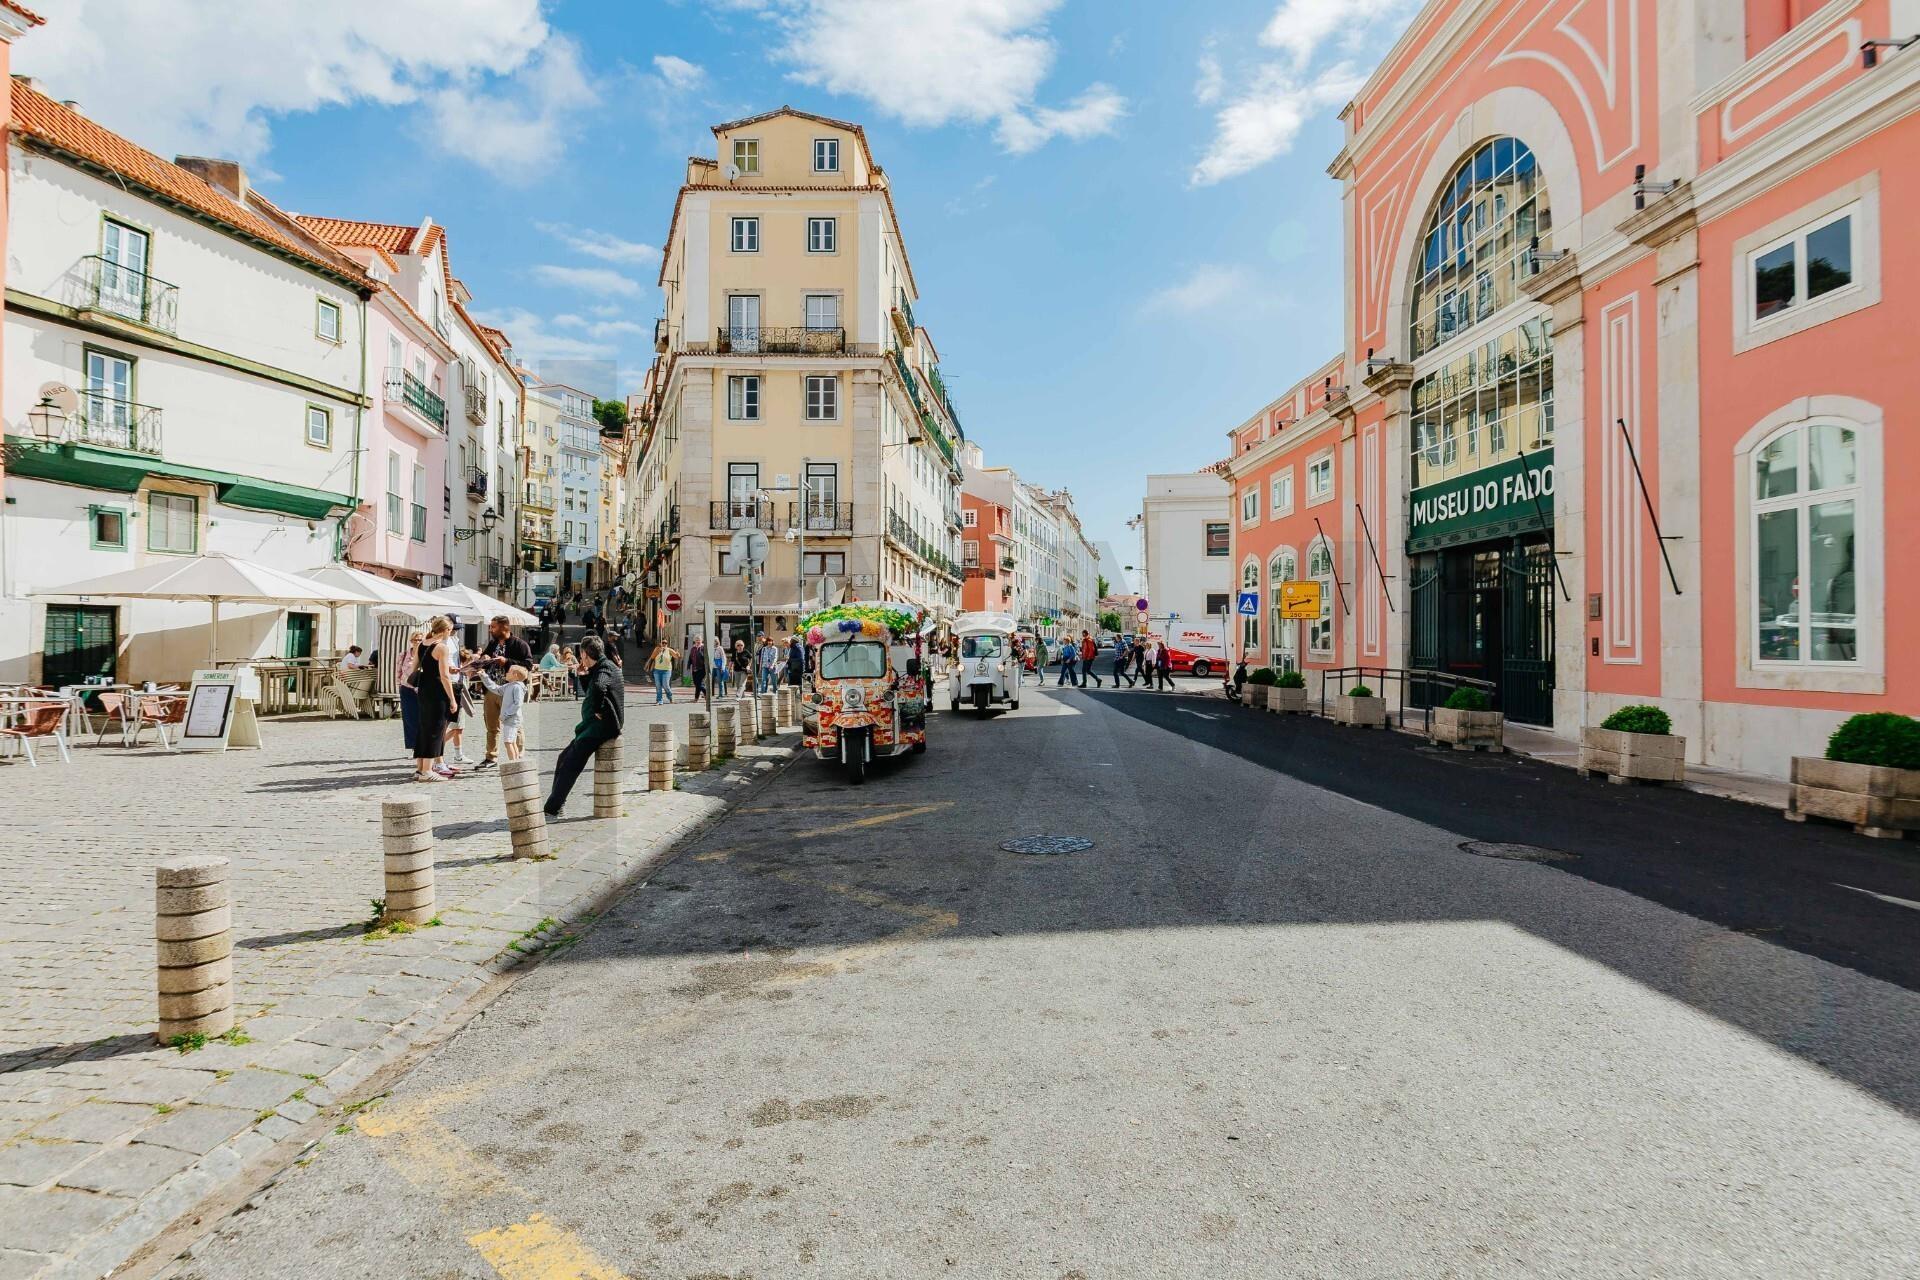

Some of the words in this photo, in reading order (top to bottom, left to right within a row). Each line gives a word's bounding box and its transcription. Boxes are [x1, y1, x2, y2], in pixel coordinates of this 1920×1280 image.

[1413, 488, 1469, 527] MUSEU
[1473, 481, 1498, 513] DO
[1503, 464, 1554, 506] FADO
